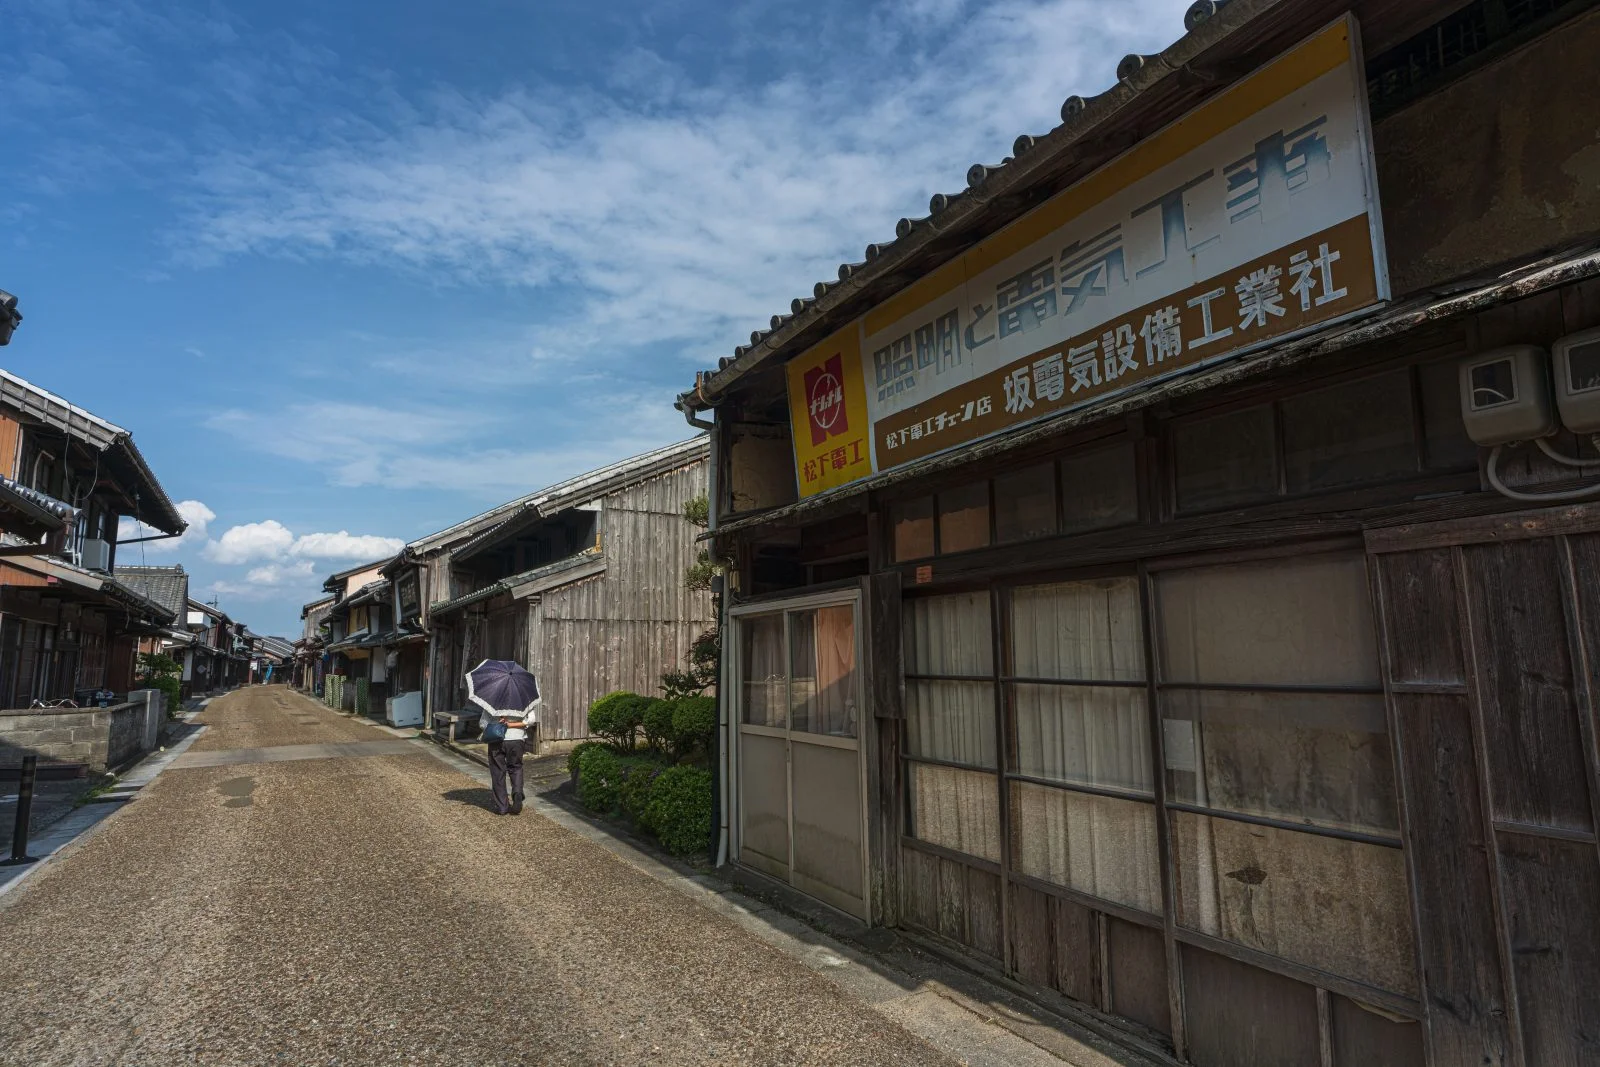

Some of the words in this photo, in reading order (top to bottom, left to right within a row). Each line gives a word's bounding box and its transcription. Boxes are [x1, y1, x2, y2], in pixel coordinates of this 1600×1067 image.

[873, 115, 1332, 403] 照明と電気工事
[1003, 242, 1348, 415] 坂電気設備工業社
[803, 439, 865, 483] 松下電工
[886, 395, 992, 450] 松下電工チェーン店
